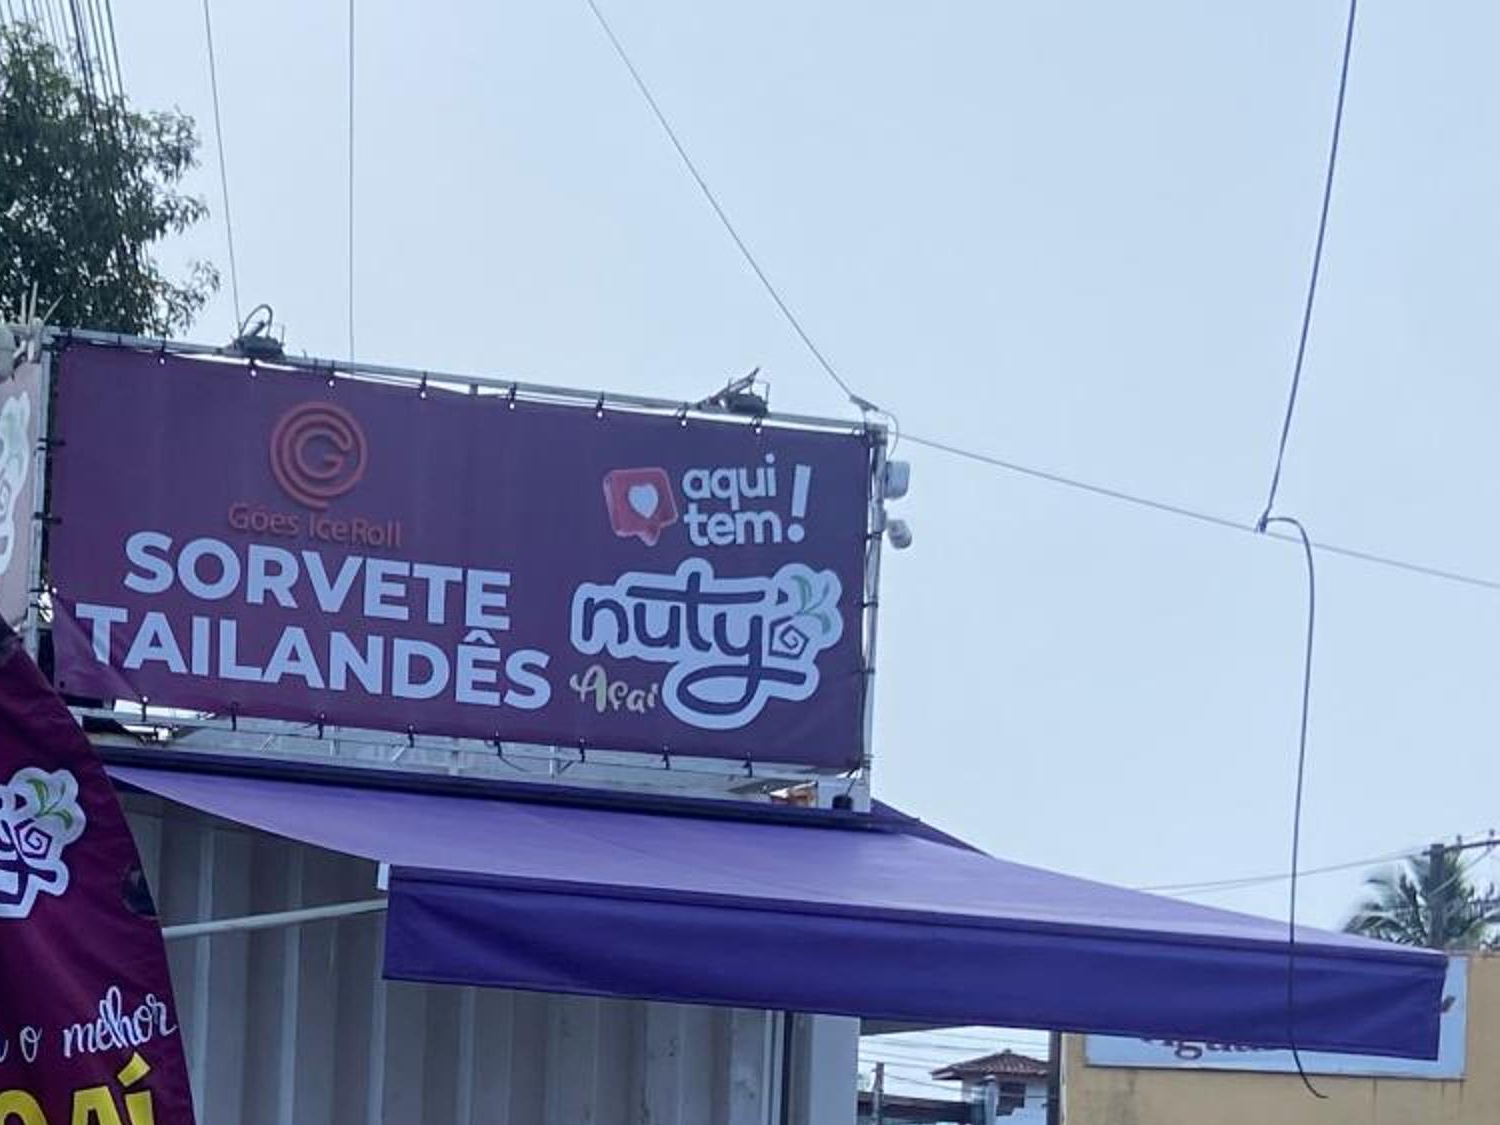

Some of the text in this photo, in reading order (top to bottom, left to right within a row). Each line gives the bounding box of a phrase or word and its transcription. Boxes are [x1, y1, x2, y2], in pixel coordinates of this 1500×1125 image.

[682, 453, 777, 510] aqui
[124, 531, 511, 631] SORVETE
[76, 603, 551, 709] TAILANDÊS
[19, 1025, 43, 1063] o
[62, 985, 178, 1058] melhor
